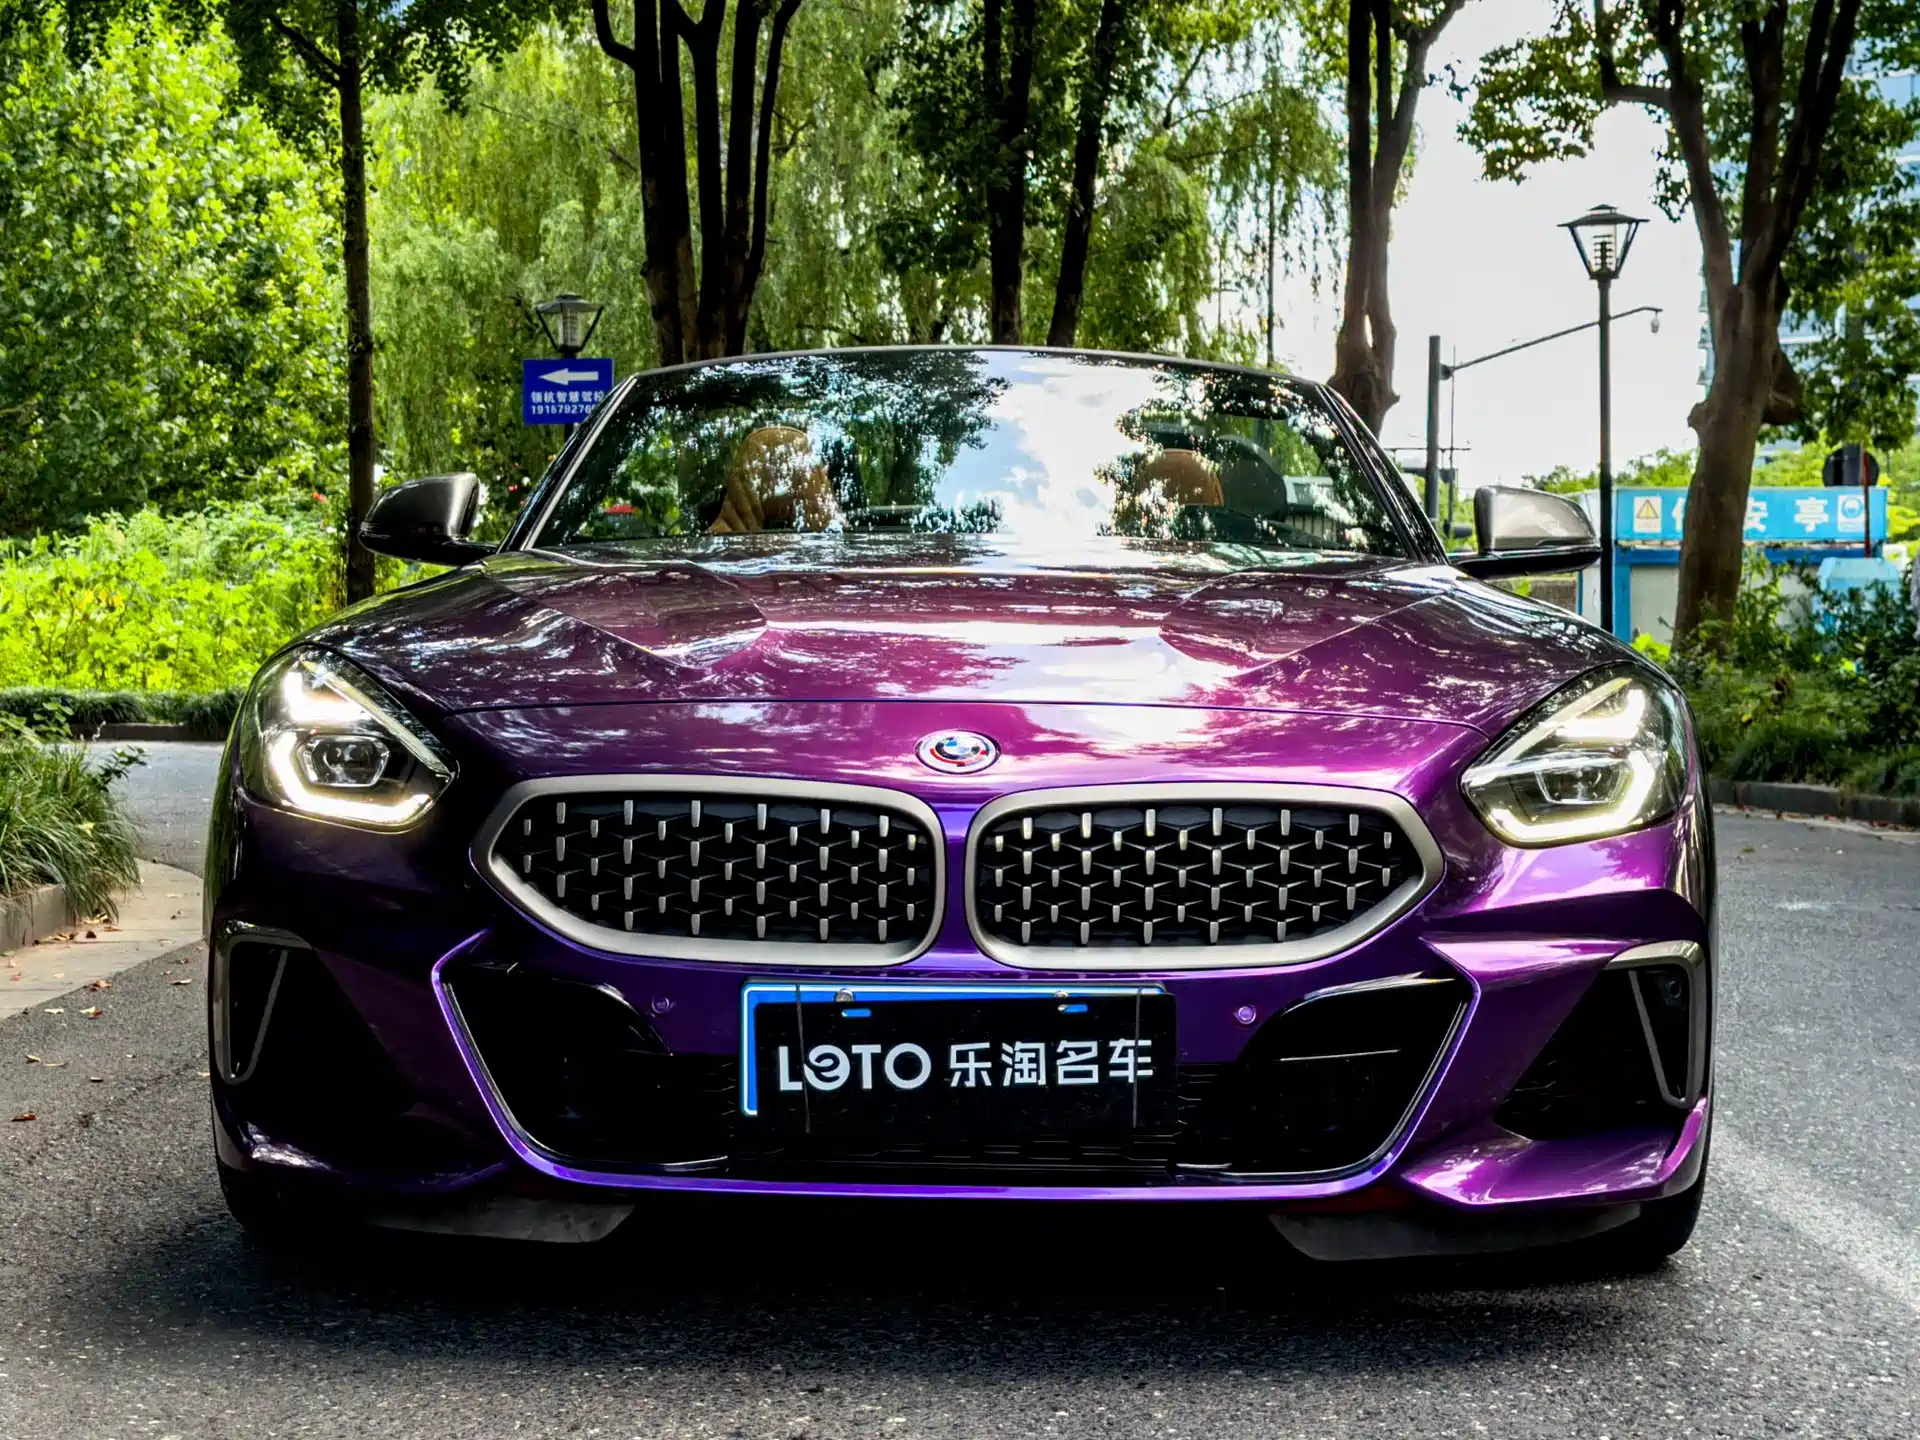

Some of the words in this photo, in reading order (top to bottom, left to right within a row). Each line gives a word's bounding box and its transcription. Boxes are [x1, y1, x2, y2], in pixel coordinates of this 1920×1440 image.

[778, 1042, 932, 1091] LOTO
[949, 1038, 1154, 1088] 乐淘名车
